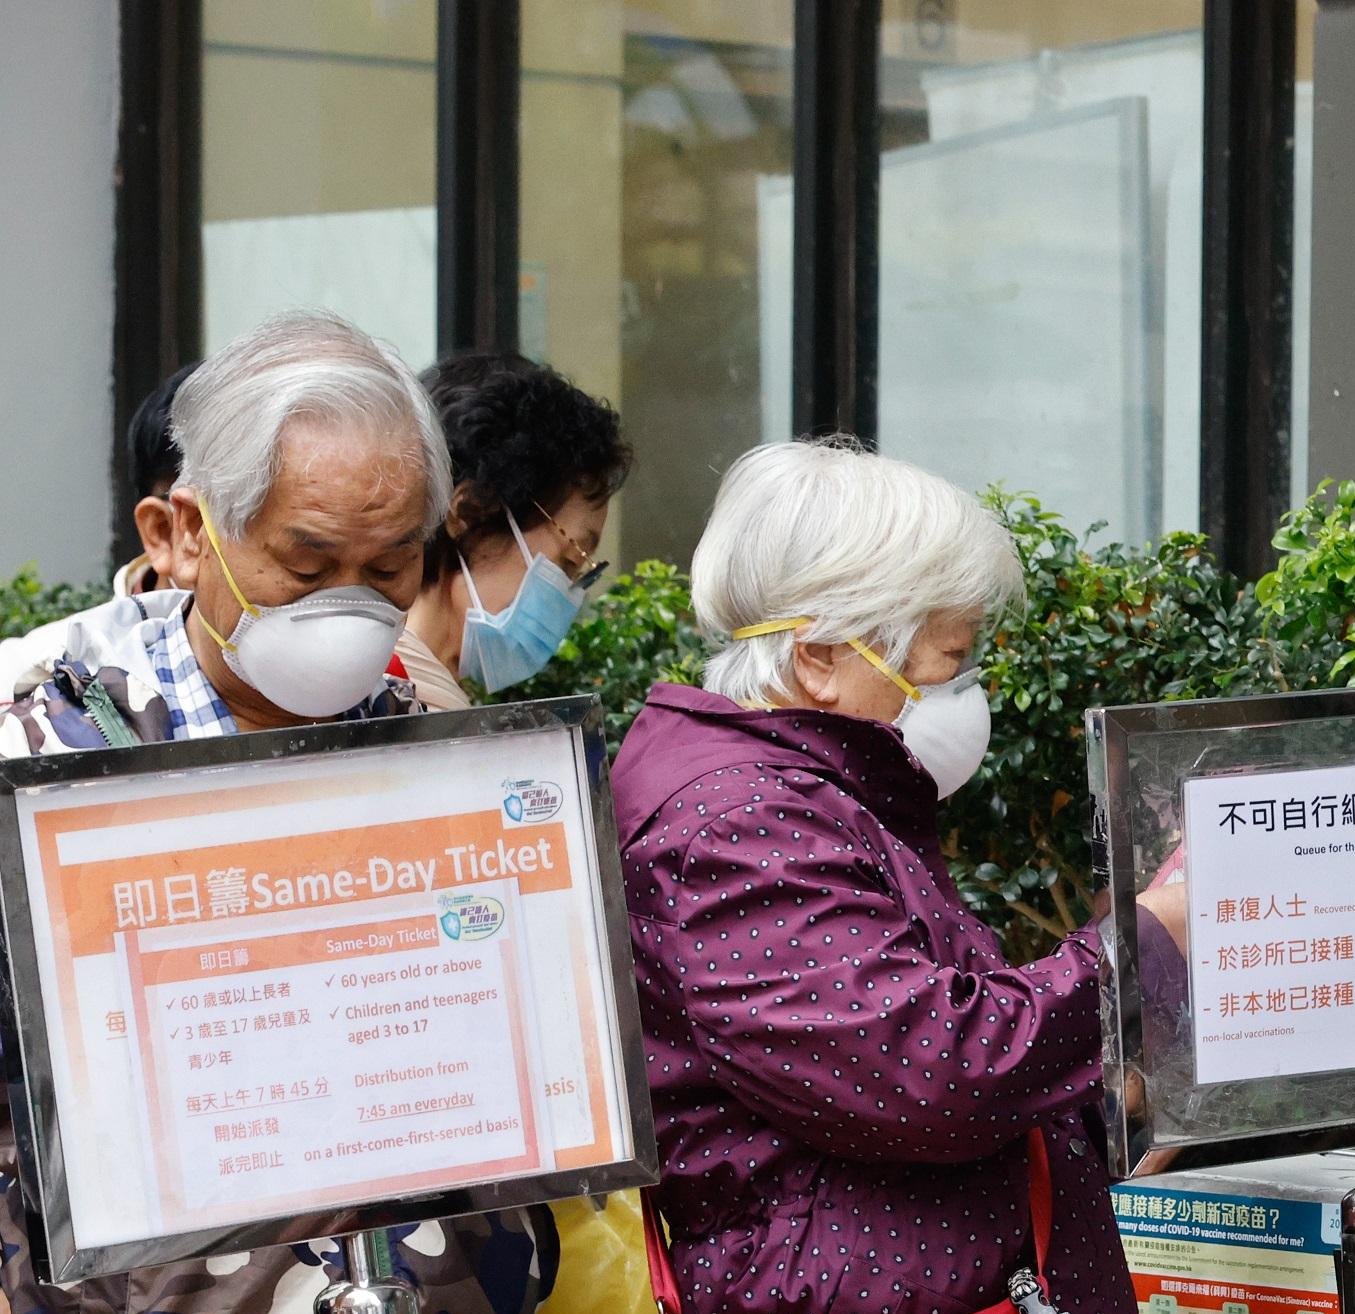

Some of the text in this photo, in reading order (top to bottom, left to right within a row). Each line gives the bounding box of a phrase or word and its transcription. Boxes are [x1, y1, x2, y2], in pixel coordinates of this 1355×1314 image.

[1294, 845, 1326, 856] Queue
[1329, 843, 1342, 853] for
[113, 838, 554, 928] 即日籌 Same-Day Ticket
[1216, 893, 1307, 924] 康復人士
[326, 927, 438, 954] Same-Day Ticket
[200, 948, 250, 970] 即日籌
[341, 957, 482, 988] 60 years old or above
[181, 982, 291, 1010] 60 歲或以上長者
[345, 988, 498, 1021] Children and teenagers
[185, 1008, 311, 1040] 3 歲至 17 歲兒童及
[348, 1019, 429, 1045] aged 3 to 17
[1202, 1026, 1295, 1043] non-local vaccinations
[188, 1050, 233, 1070] 青少年
[354, 1059, 469, 1088] Distribution from
[186, 1076, 329, 1113] 每天上午 7 時 45 分
[358, 1092, 474, 1120] 7:45 am everyday
[214, 1116, 280, 1143] 開始派發
[304, 1115, 519, 1162] on a first-come-first-served basis
[218, 1150, 285, 1177] 派完即止
[1138, 1221, 1305, 1247] doses of COVID-19 vaccine recommended for me?
